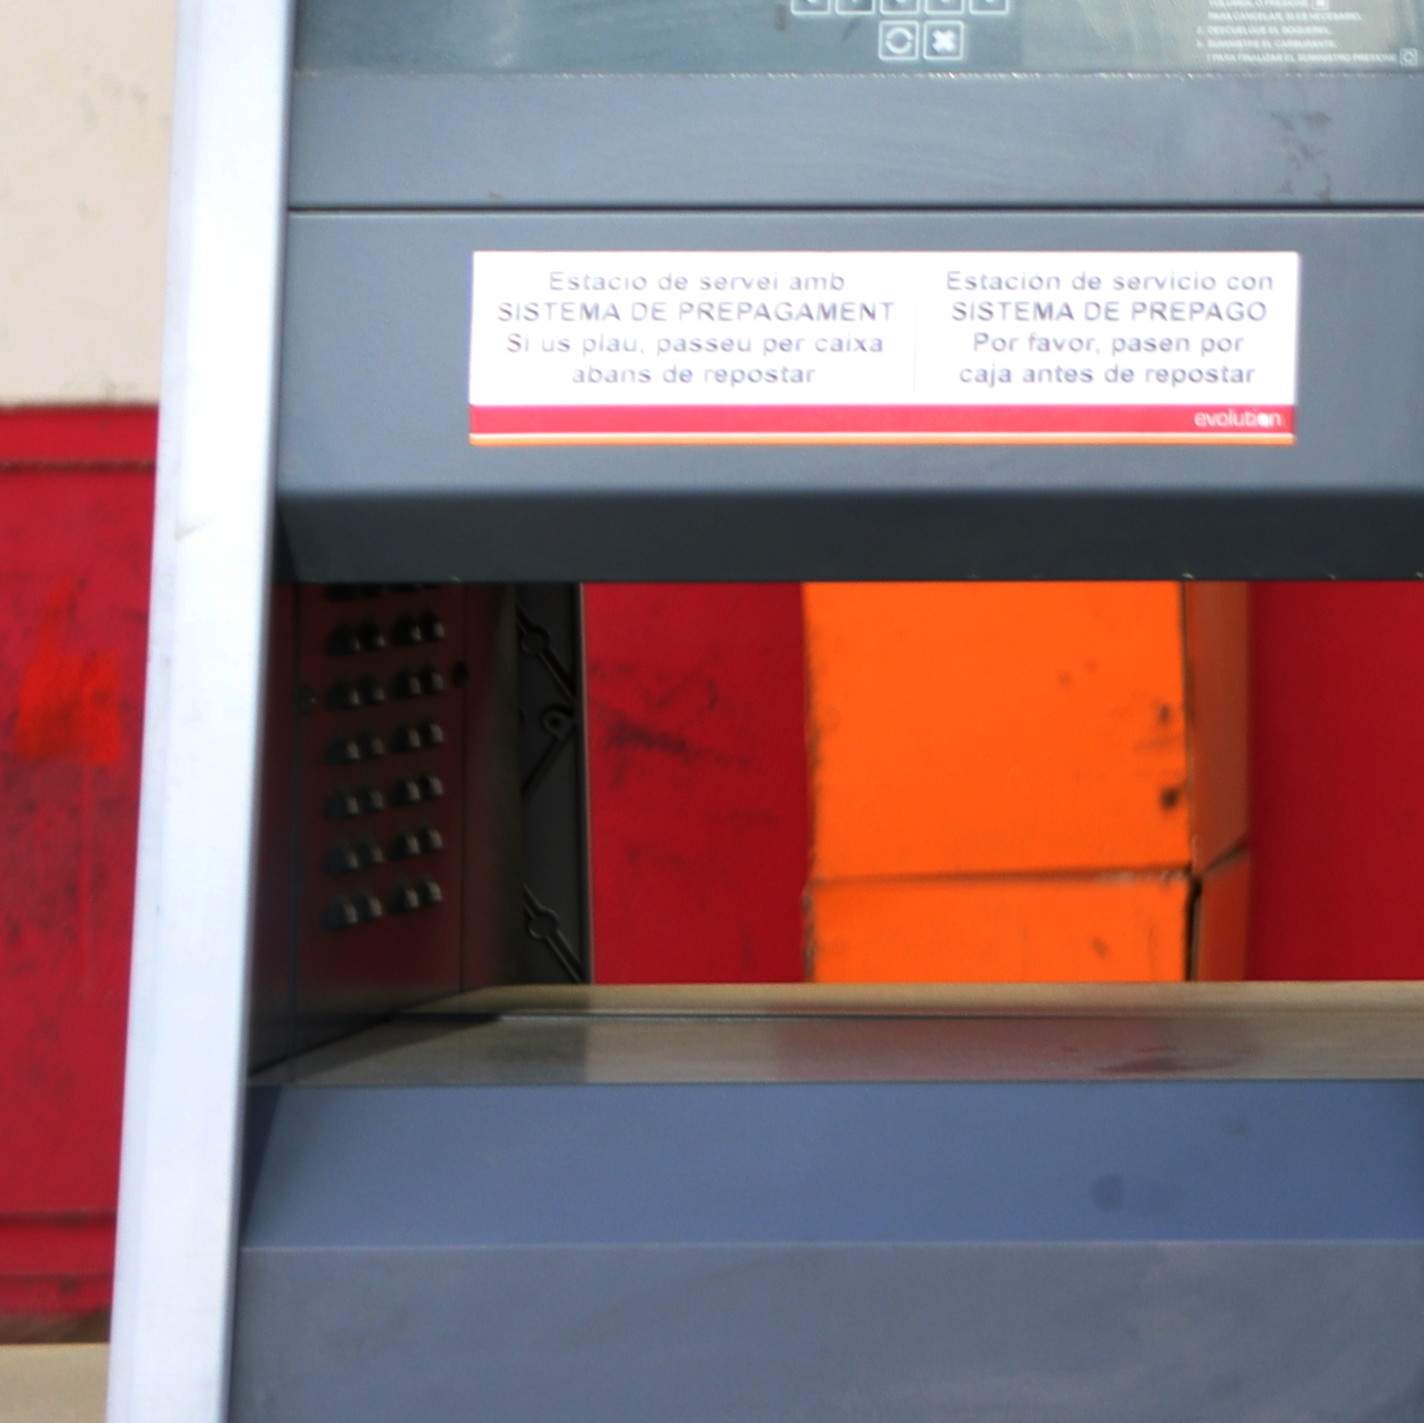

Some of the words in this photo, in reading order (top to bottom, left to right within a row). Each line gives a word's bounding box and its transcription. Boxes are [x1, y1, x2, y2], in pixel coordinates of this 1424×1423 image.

[658, 272, 689, 291] de
[699, 272, 778, 291] servei
[790, 272, 845, 291] amb
[946, 270, 1061, 291] Estación
[1072, 271, 1102, 291] de
[1112, 271, 1216, 291] servicio
[1226, 274, 1274, 291] con
[498, 301, 621, 322] SISTEMA
[631, 302, 668, 321] DE
[679, 302, 895, 322] PREPAGAMENT
[952, 301, 1075, 322] SISTEMA
[1084, 302, 1120, 321] DE
[1132, 302, 1267, 322] PREPAGO
[506, 332, 530, 353] Si
[541, 336, 571, 353] us
[657, 336, 752, 358] passeu
[763, 336, 804, 357] per
[814, 334, 883, 353] caixa
[973, 332, 1018, 353] Por
[1028, 331, 1100, 355] favor,
[1111, 335, 1190, 357] pasen
[1201, 335, 1245, 357] por
[572, 365, 652, 384] abans
[663, 365, 694, 384] de
[704, 366, 815, 387] repostar
[959, 364, 1012, 388] caja
[1022, 366, 1094, 384] antes
[1104, 364, 1135, 384] de
[1145, 366, 1255, 388] repostar
[1194, 408, 1282, 428] evolution
